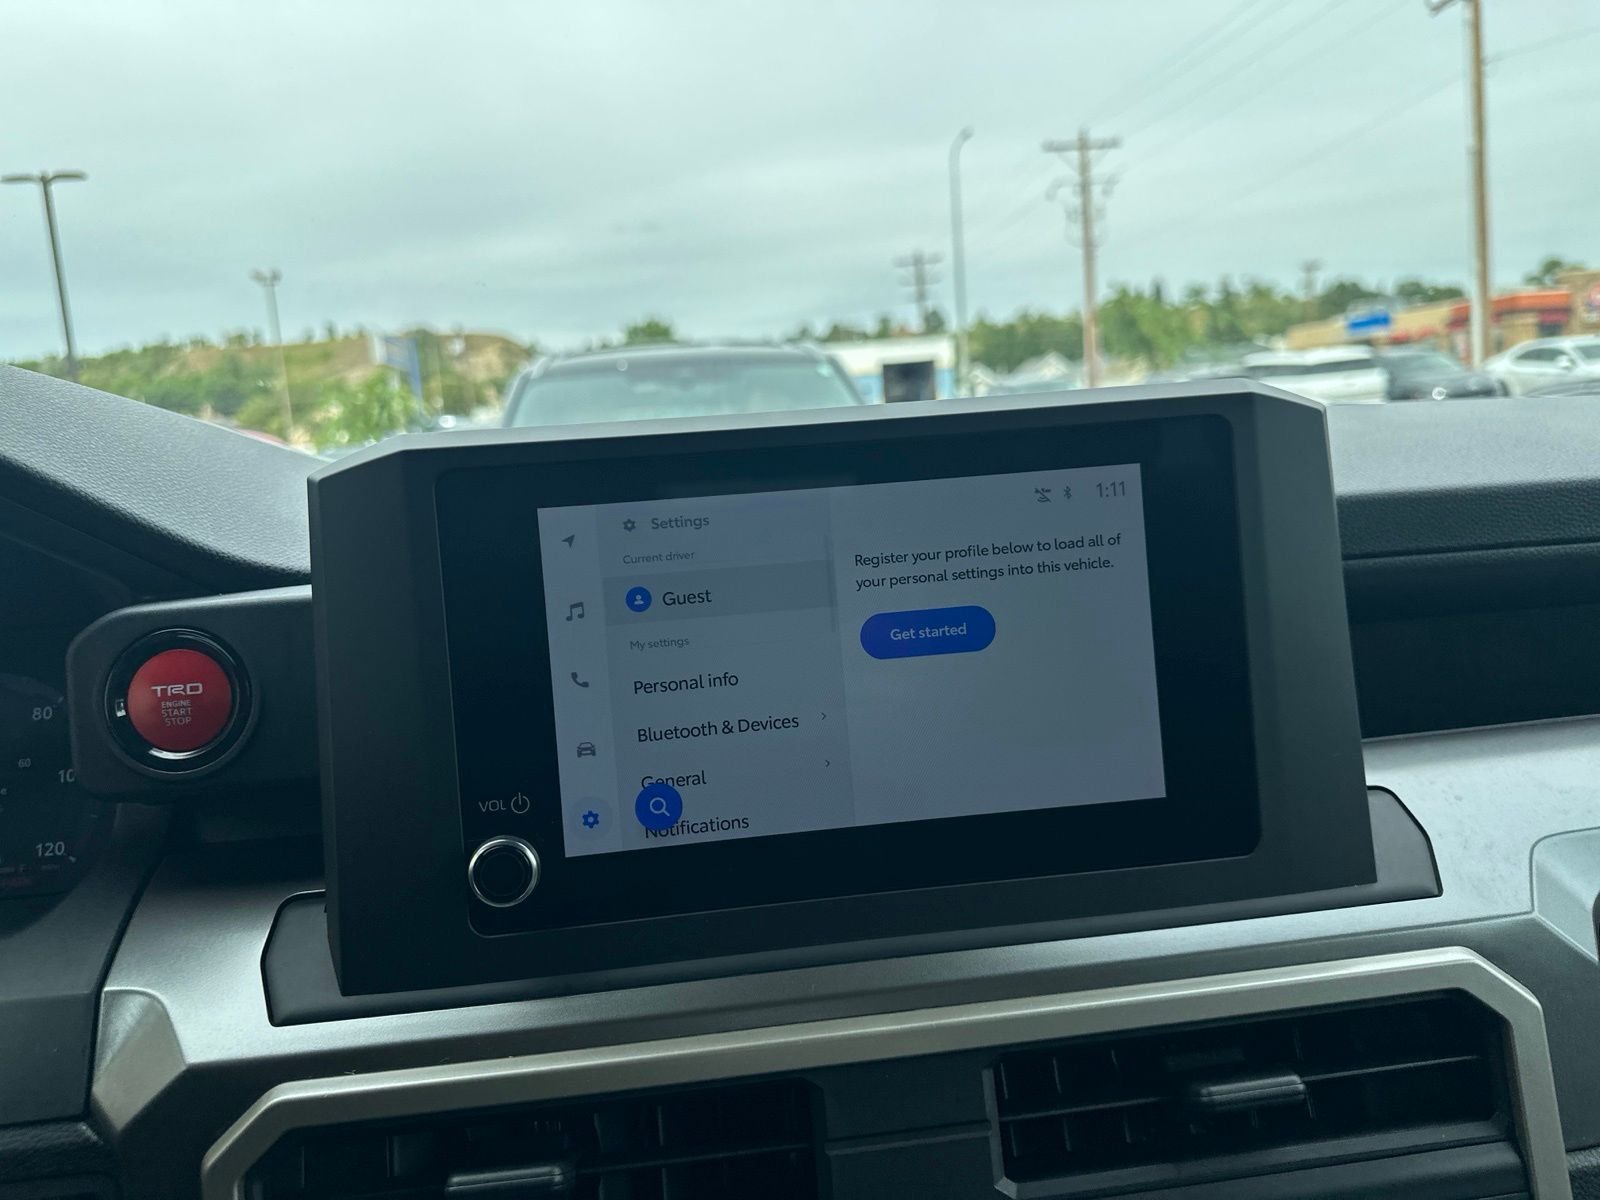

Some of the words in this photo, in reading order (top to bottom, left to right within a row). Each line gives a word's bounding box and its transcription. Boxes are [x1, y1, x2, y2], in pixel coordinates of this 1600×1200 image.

[1096, 480, 1127, 498] 1:11
[651, 516, 710, 530] Settings
[855, 552, 909, 568] Register
[912, 550, 941, 564] your
[945, 545, 988, 562] profile
[992, 542, 1033, 556] below
[1037, 540, 1051, 551] to
[1054, 536, 1084, 550] load
[1088, 535, 1104, 547] all
[1107, 533, 1122, 545] of
[623, 553, 662, 565] Current
[665, 552, 695, 561] driver
[856, 575, 886, 591] your
[889, 569, 948, 588] personal
[951, 566, 1004, 582] settings
[1008, 563, 1034, 576] into
[1037, 560, 1061, 573] this
[1064, 557, 1114, 571] vehicle.
[663, 590, 712, 606] Guest
[890, 627, 916, 641] Get
[919, 623, 967, 638] started
[630, 641, 645, 651] My
[648, 637, 689, 648] settings
[151, 683, 203, 697] TRD
[634, 675, 704, 694] Personal
[708, 672, 739, 688] info
[161, 700, 191, 709] ENGINE
[32, 706, 53, 720] 80
[162, 708, 192, 717] START
[165, 717, 192, 726] STOP
[637, 721, 718, 742] Bluetooth
[722, 721, 734, 735] &
[738, 715, 799, 733] Devices
[18, 758, 31, 768] 60
[641, 771, 707, 789] General
[478, 800, 506, 812] VOL
[36, 841, 65, 857] 120
